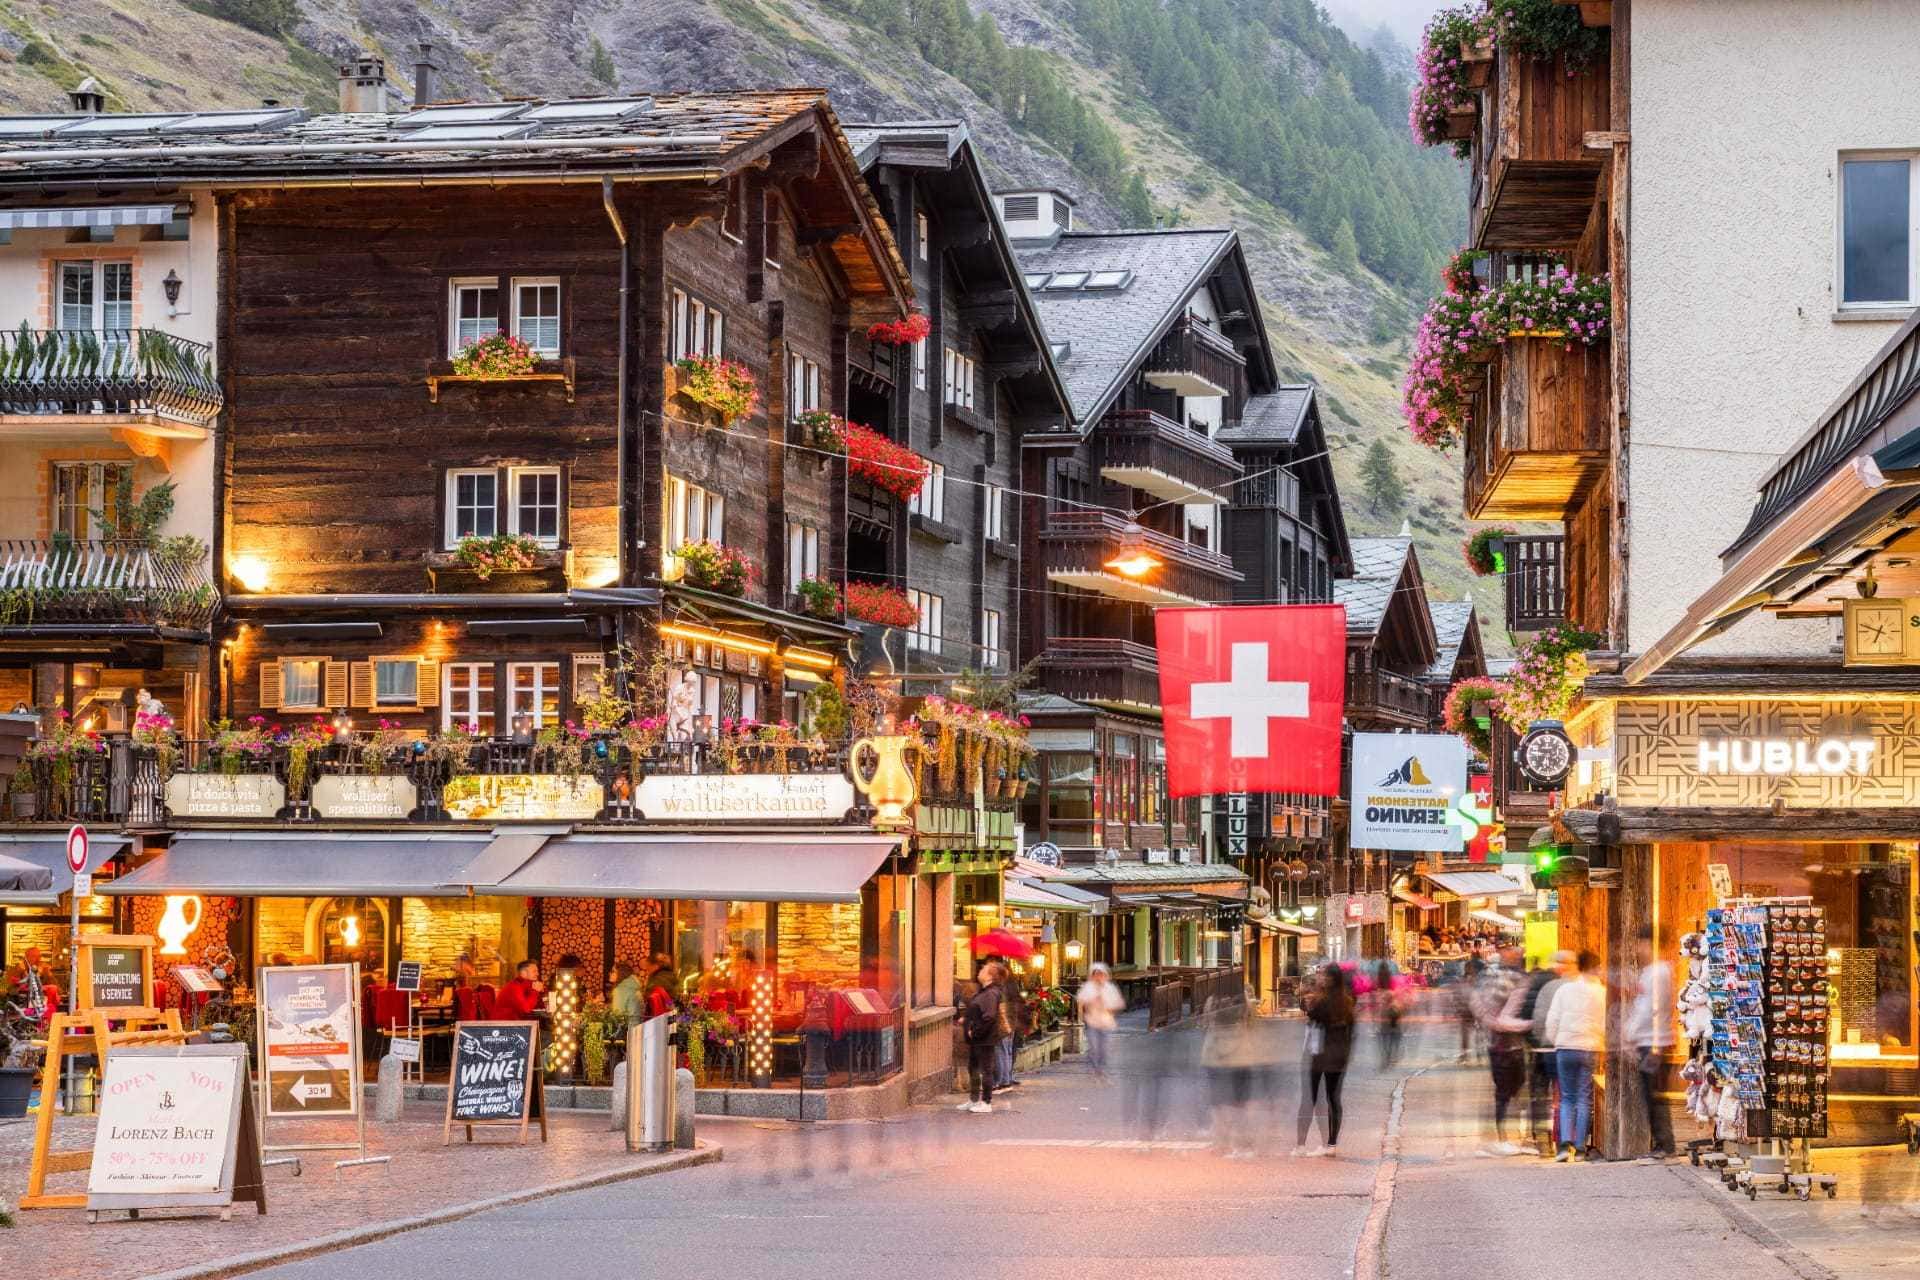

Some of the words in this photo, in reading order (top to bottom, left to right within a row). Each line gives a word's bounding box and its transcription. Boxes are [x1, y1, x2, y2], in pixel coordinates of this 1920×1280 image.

[1698, 740, 1875, 774] HUBLOT
[237, 789, 259, 800] vita
[341, 788, 388, 801] walliser
[188, 802, 218, 814] pizza
[220, 802, 229, 813] &
[231, 804, 262, 815] pasta
[662, 792, 826, 813] walliserkanne
[1230, 759, 1246, 854] OLLUX
[106, 988, 133, 1000] SERVICE
[111, 1072, 156, 1095] OPEN
[188, 1071, 224, 1093] NOW
[307, 1087, 319, 1095] 30
[456, 1105, 477, 1117] FINE
[479, 1102, 512, 1114] WINES
[111, 1126, 168, 1140] LORENZ
[173, 1126, 215, 1140] BACH
[110, 1151, 137, 1165] 50%
[150, 1151, 176, 1165] 75%
[179, 1151, 207, 1166] OFF
